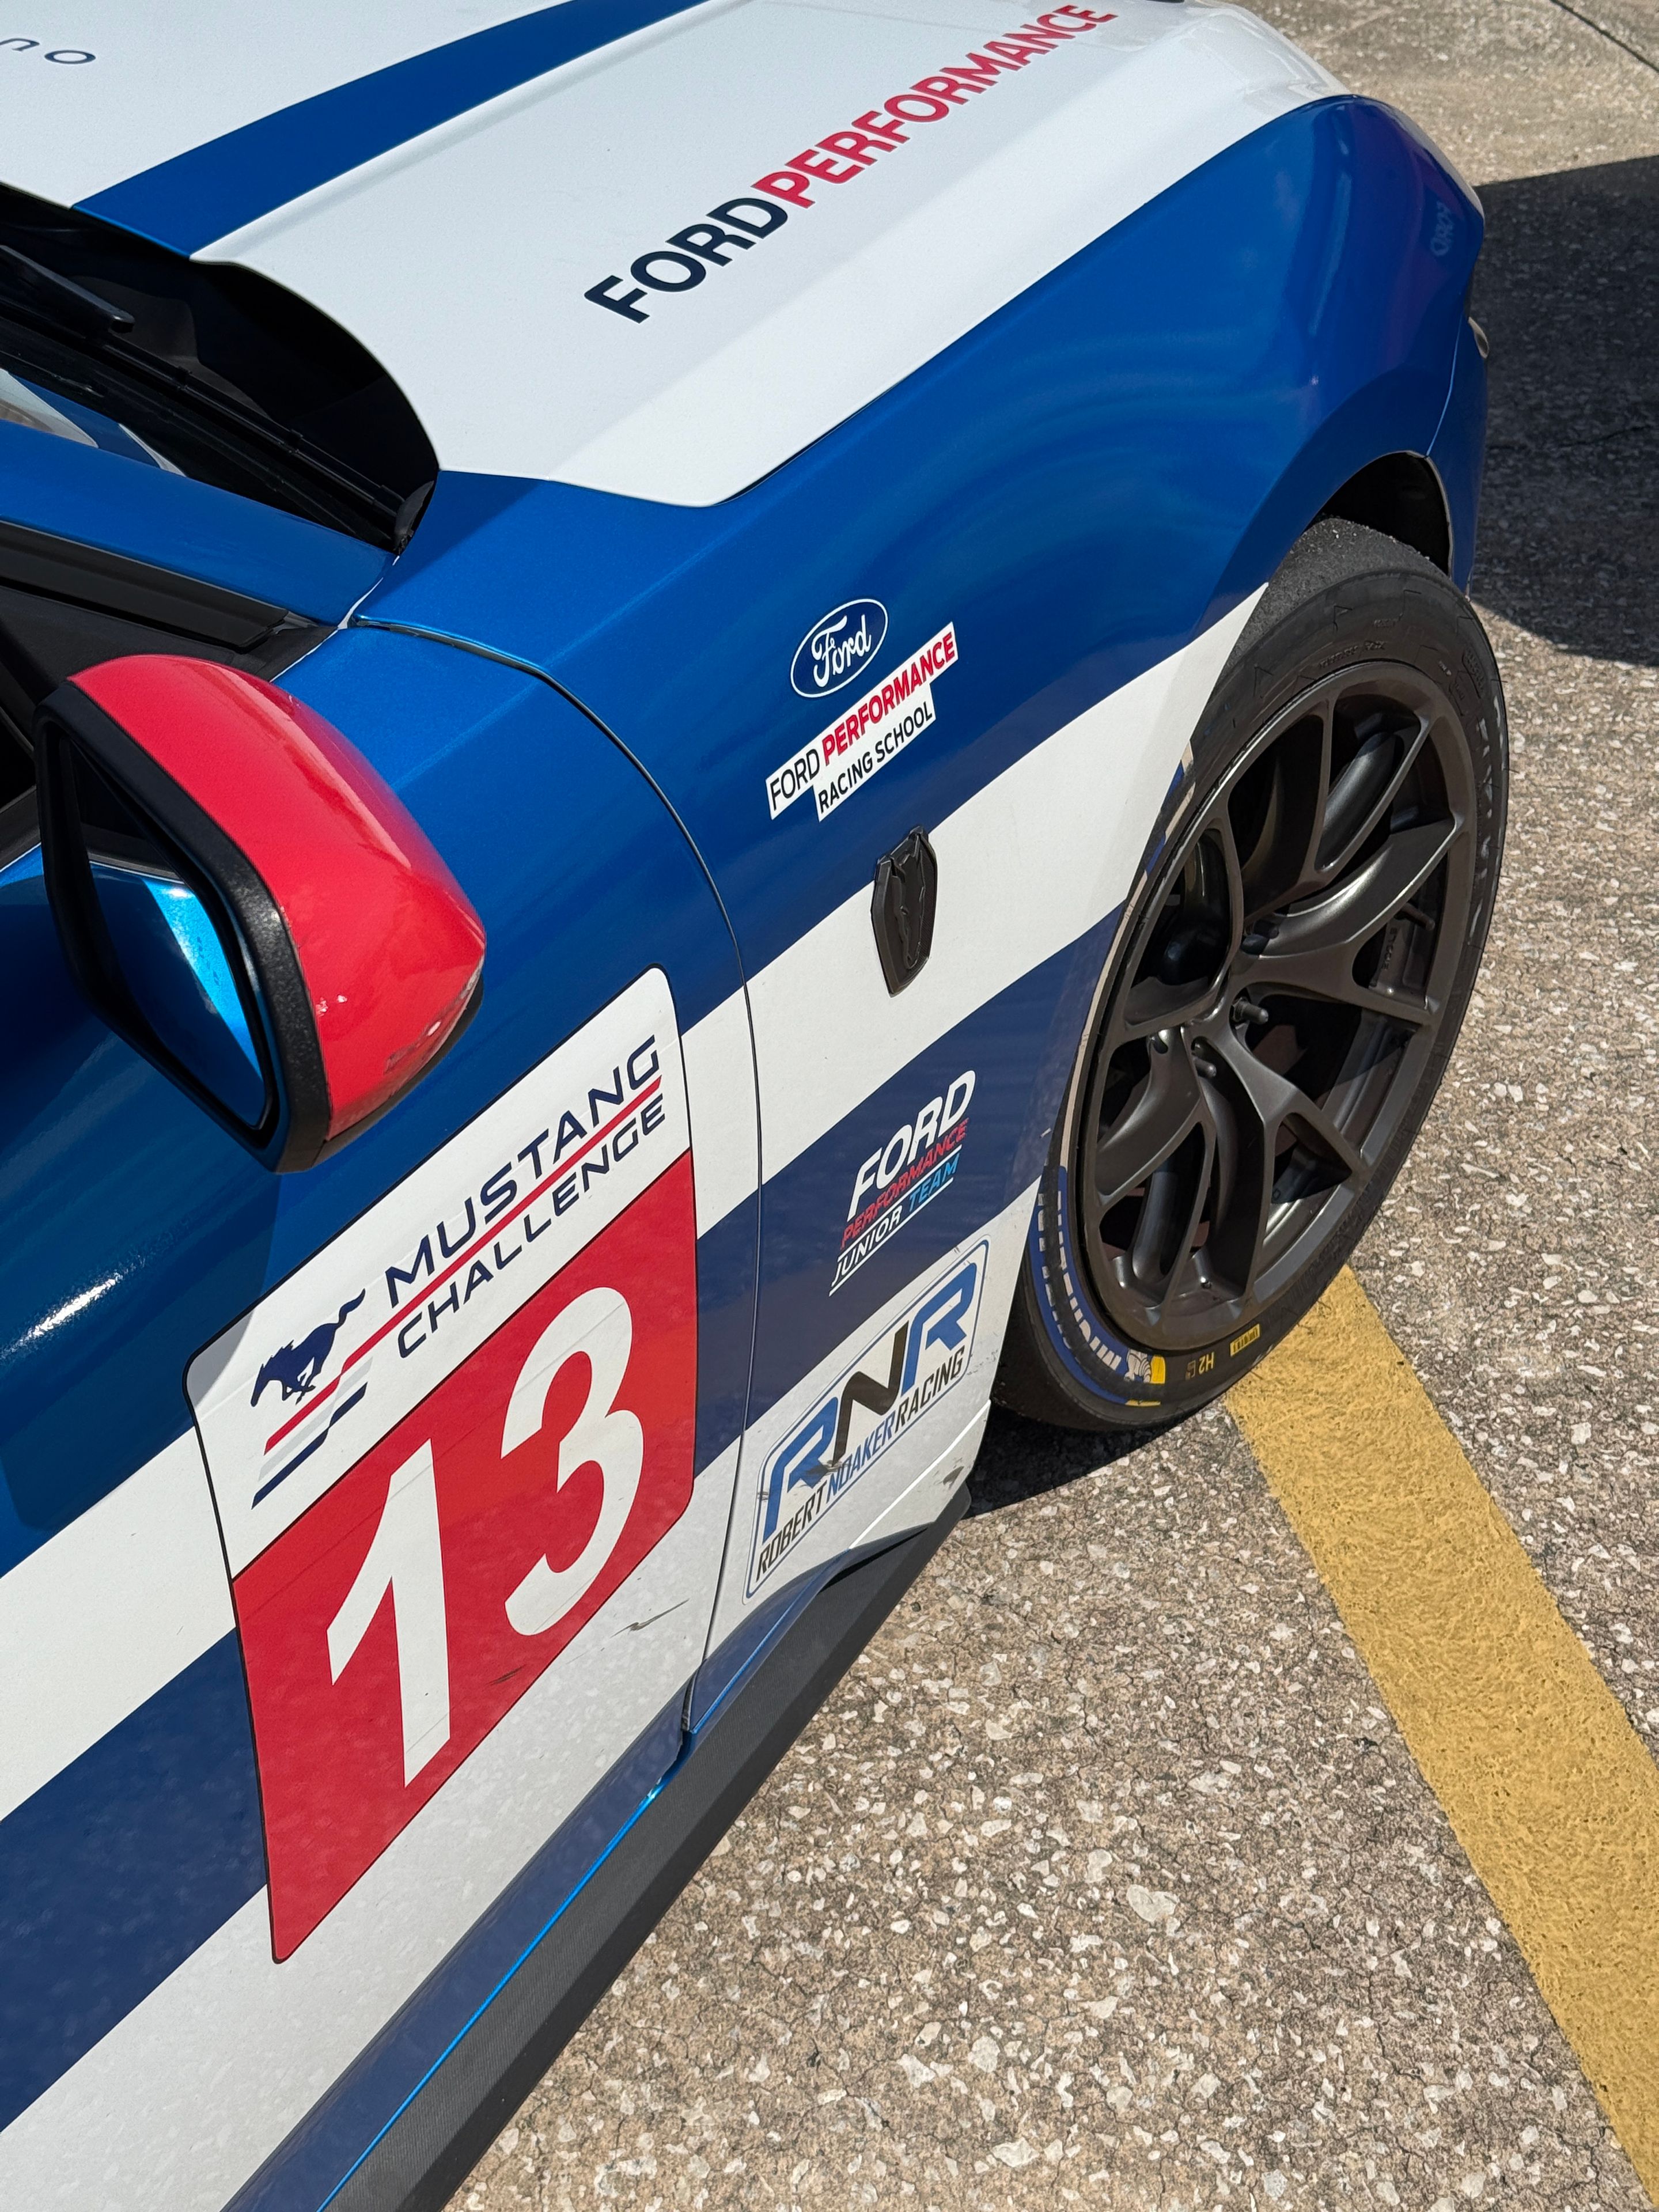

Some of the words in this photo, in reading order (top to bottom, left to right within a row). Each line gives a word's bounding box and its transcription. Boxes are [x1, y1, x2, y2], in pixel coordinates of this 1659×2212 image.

[770, 749, 820, 811] FORD
[822, 631, 956, 767] PERFORMANCE
[811, 614, 872, 687] Ford
[818, 752, 873, 813] RACING
[875, 701, 933, 763] SCHOOL
[384, 1036, 660, 1309] MUSTANG
[397, 1093, 666, 1359] CHALLENGE
[831, 1205, 903, 1287] JUNIOR
[908, 1153, 960, 1212] TEAM
[840, 1118, 969, 1250] PERFORMANCE
[847, 1070, 976, 1222] FORD
[756, 1480, 828, 1582] ROBERT
[827, 1410, 897, 1505] NOAKER
[895, 1346, 966, 1434] RACING
[763, 1263, 978, 1546] RNR
[326, 1286, 644, 1789] 13
